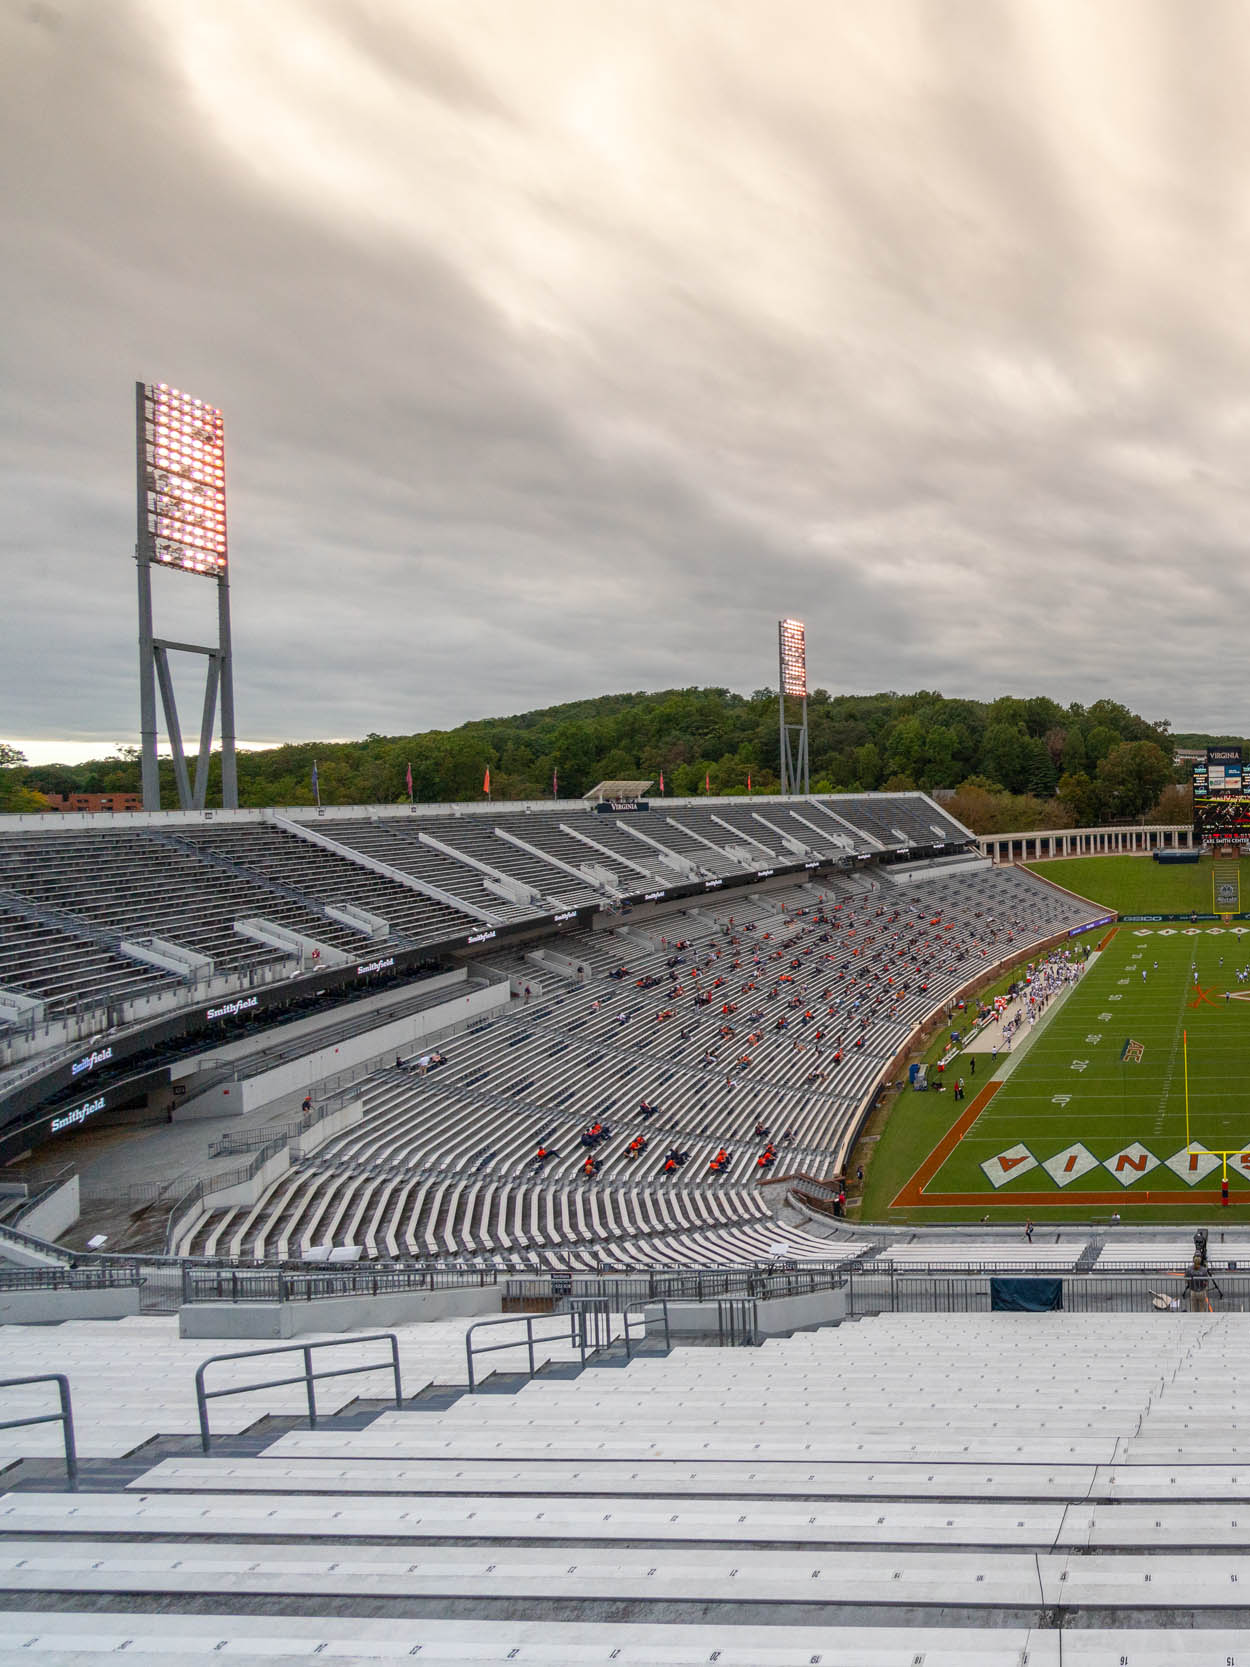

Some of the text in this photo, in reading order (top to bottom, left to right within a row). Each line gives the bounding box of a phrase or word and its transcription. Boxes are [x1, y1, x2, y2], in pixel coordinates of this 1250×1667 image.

[611, 803, 638, 811] VIRGINIA
[467, 930, 496, 944] Smithfield
[357, 958, 395, 975] Smithfield
[206, 997, 259, 1020] Smithfield
[71, 1047, 113, 1076] Smithfield
[51, 1097, 106, 1132] Smithfield
